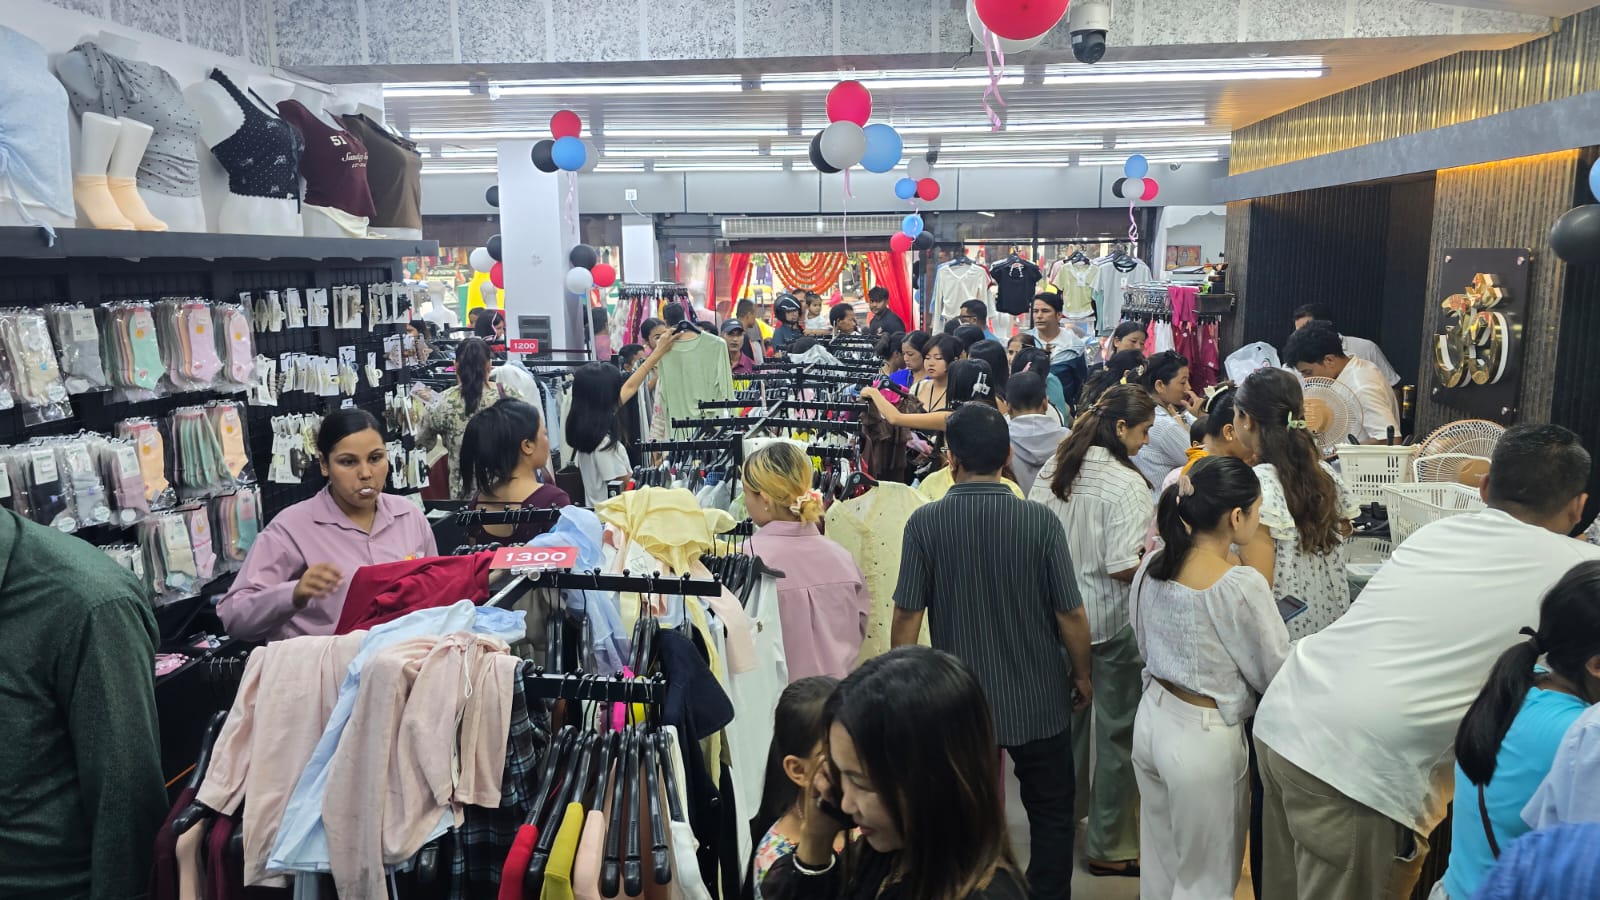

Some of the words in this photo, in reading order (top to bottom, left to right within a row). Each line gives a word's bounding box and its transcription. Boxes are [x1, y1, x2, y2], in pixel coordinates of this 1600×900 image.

[329, 135, 347, 146] 51
[513, 342, 535, 350] 1200
[505, 551, 567, 562] 1300
